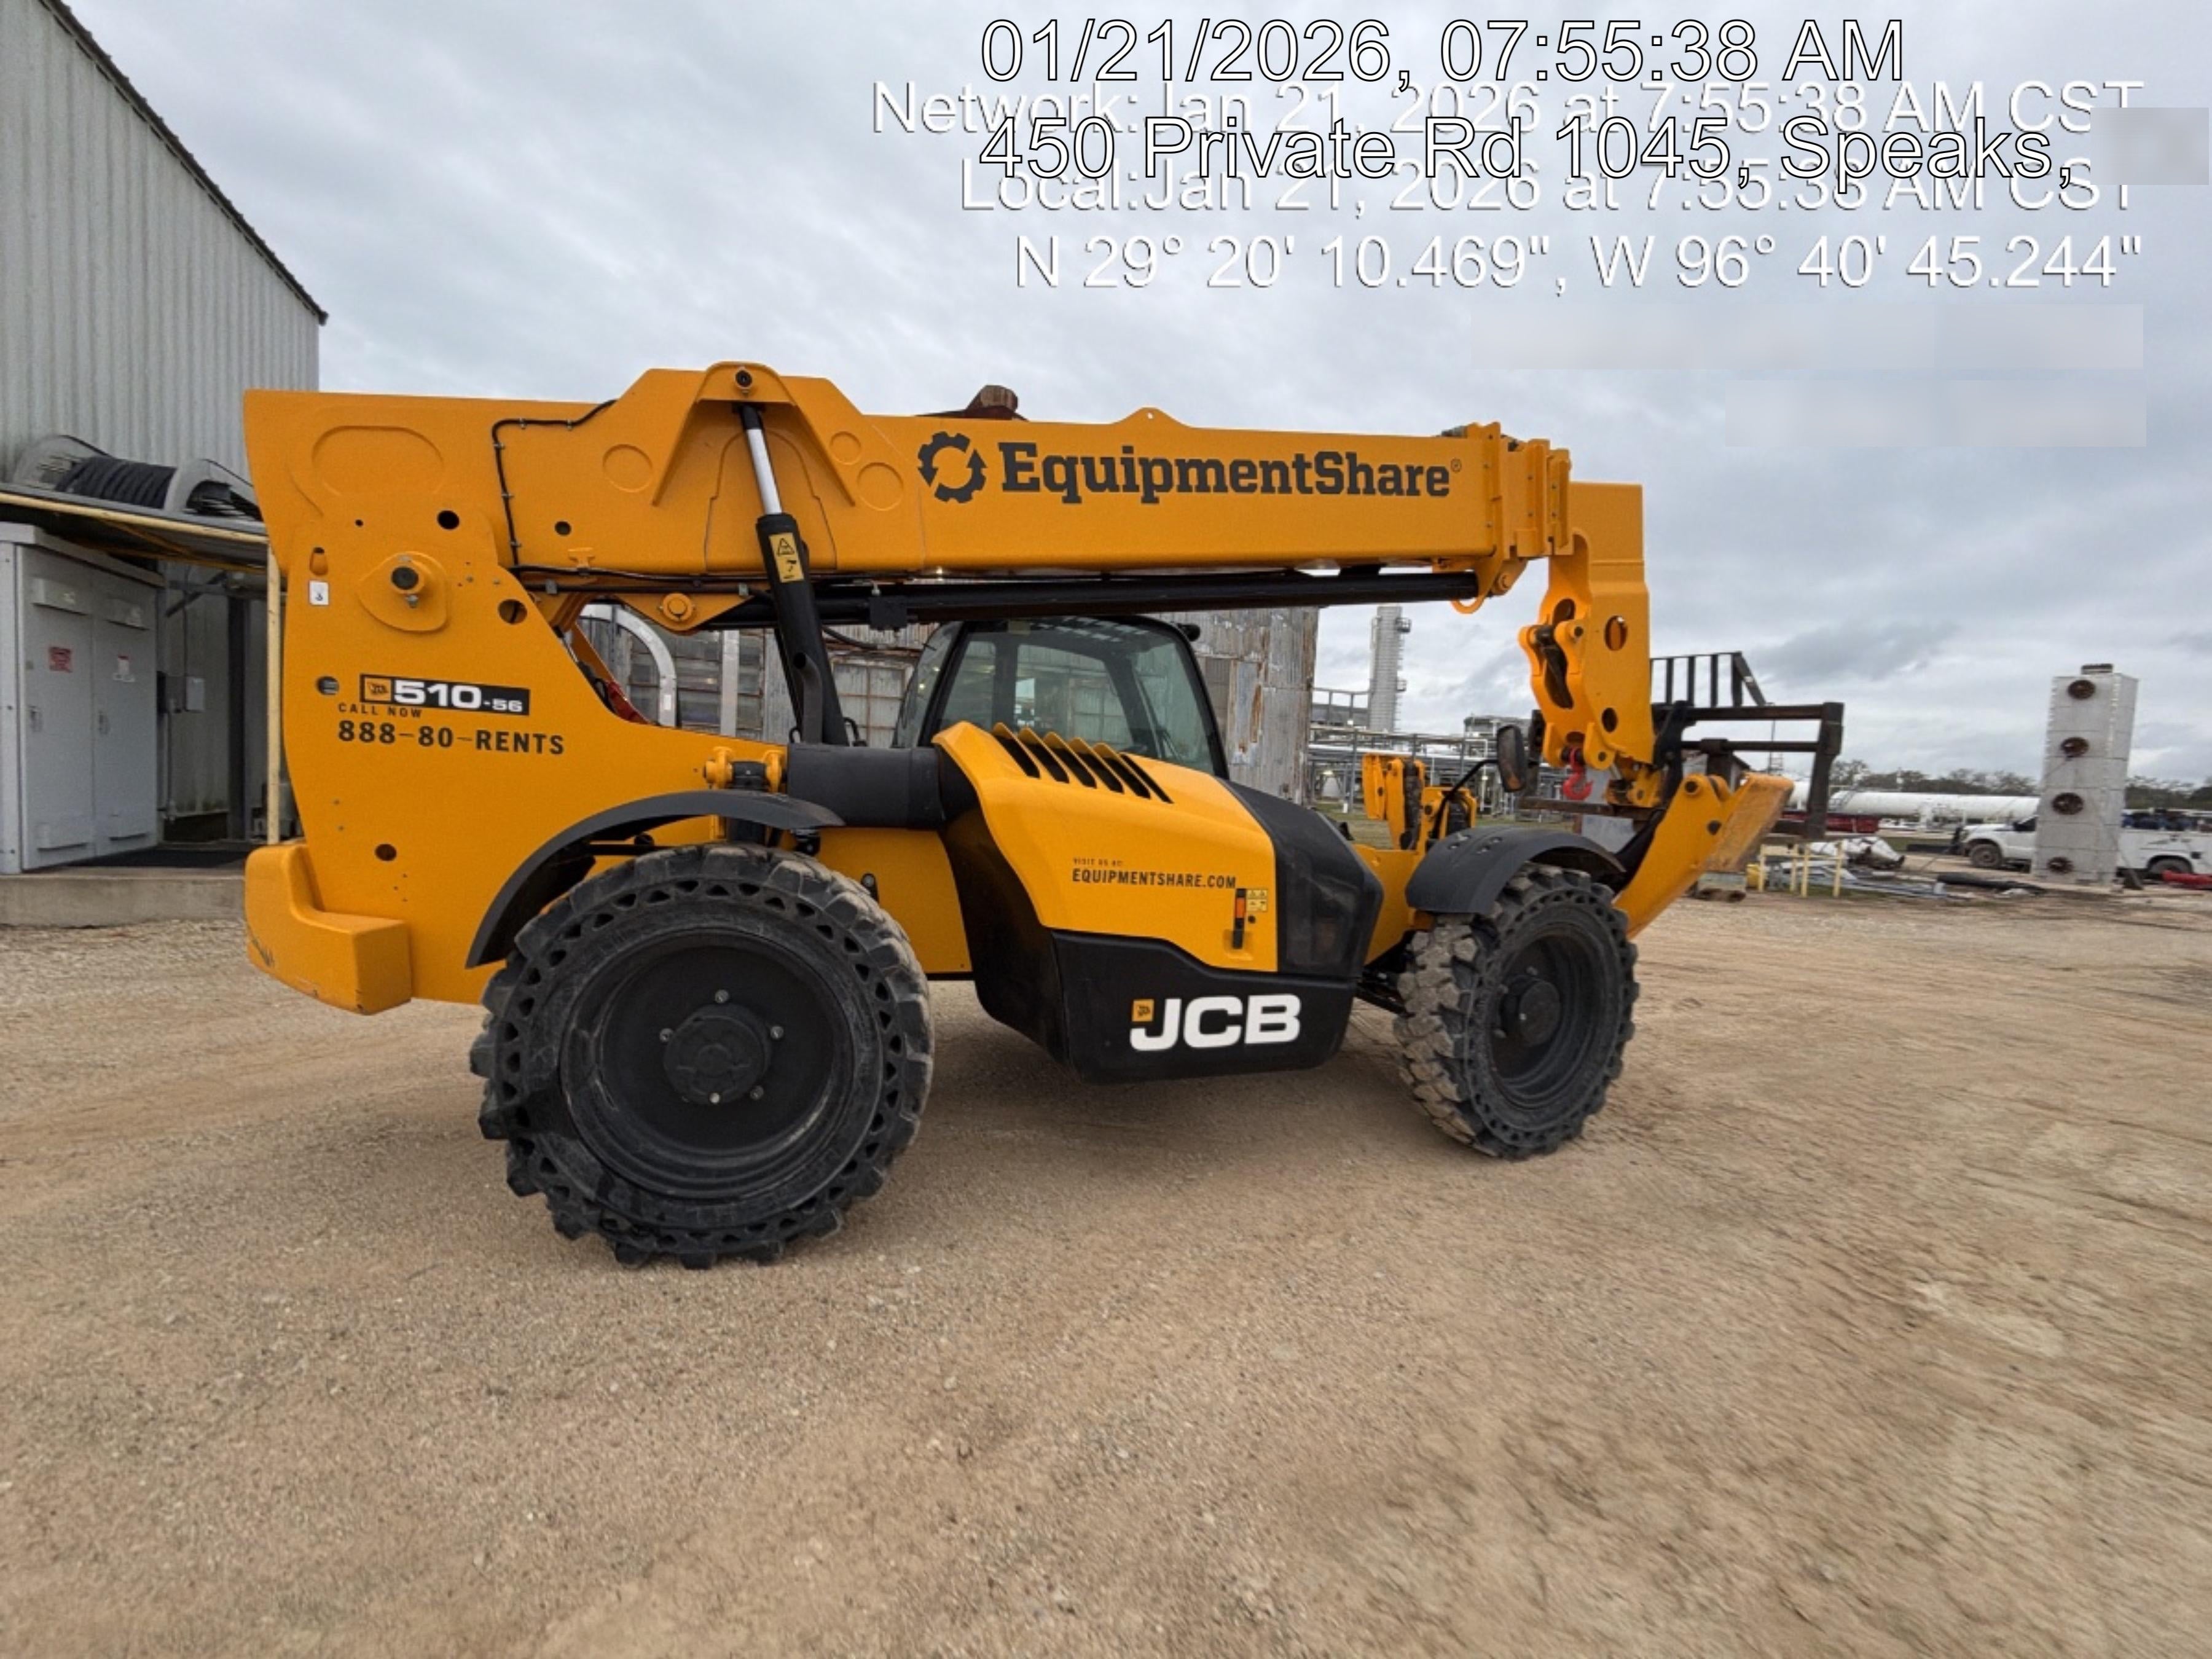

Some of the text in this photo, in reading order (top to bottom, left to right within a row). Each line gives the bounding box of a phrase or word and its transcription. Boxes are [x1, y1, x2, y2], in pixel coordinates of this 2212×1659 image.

[338, 702, 423, 718] CALL NOW
[1072, 868, 1236, 888] EQUIPMENTSHARE.COM
[1129, 994, 1301, 1051] JCB
